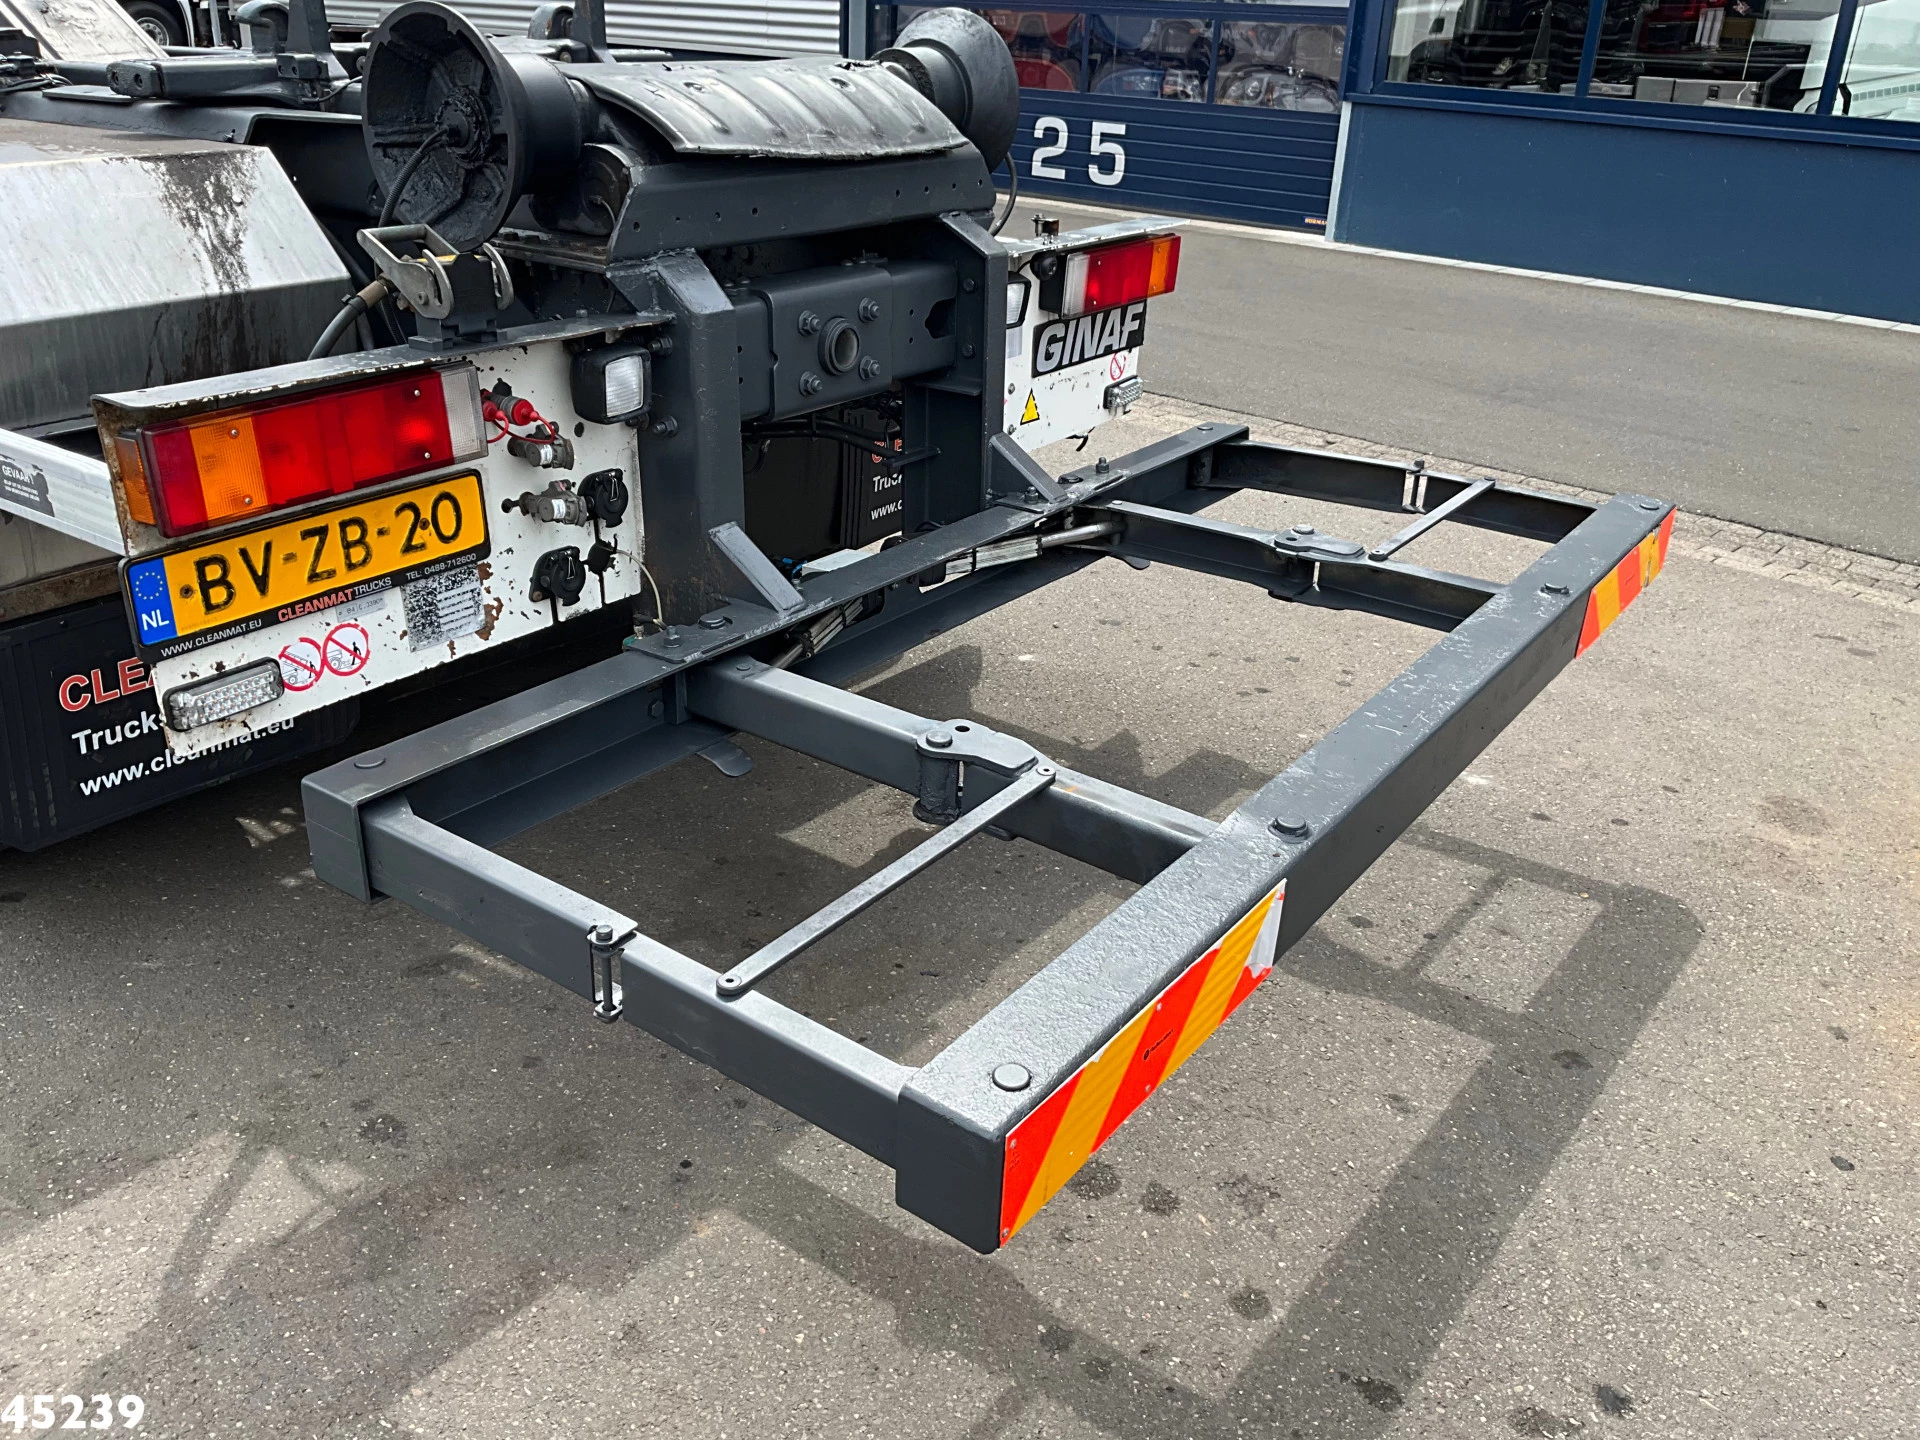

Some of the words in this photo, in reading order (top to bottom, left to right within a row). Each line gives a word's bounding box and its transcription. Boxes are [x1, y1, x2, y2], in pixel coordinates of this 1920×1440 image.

[1031, 116, 1126, 186] 25
[1036, 302, 1144, 373] GINAF
[193, 490, 463, 616] BV-ZB-20
[141, 608, 170, 631] NL
[160, 618, 263, 658] WWW.CLEANMAT.EU
[424, 552, 477, 576] 0488-712600
[58, 656, 156, 712] CLE
